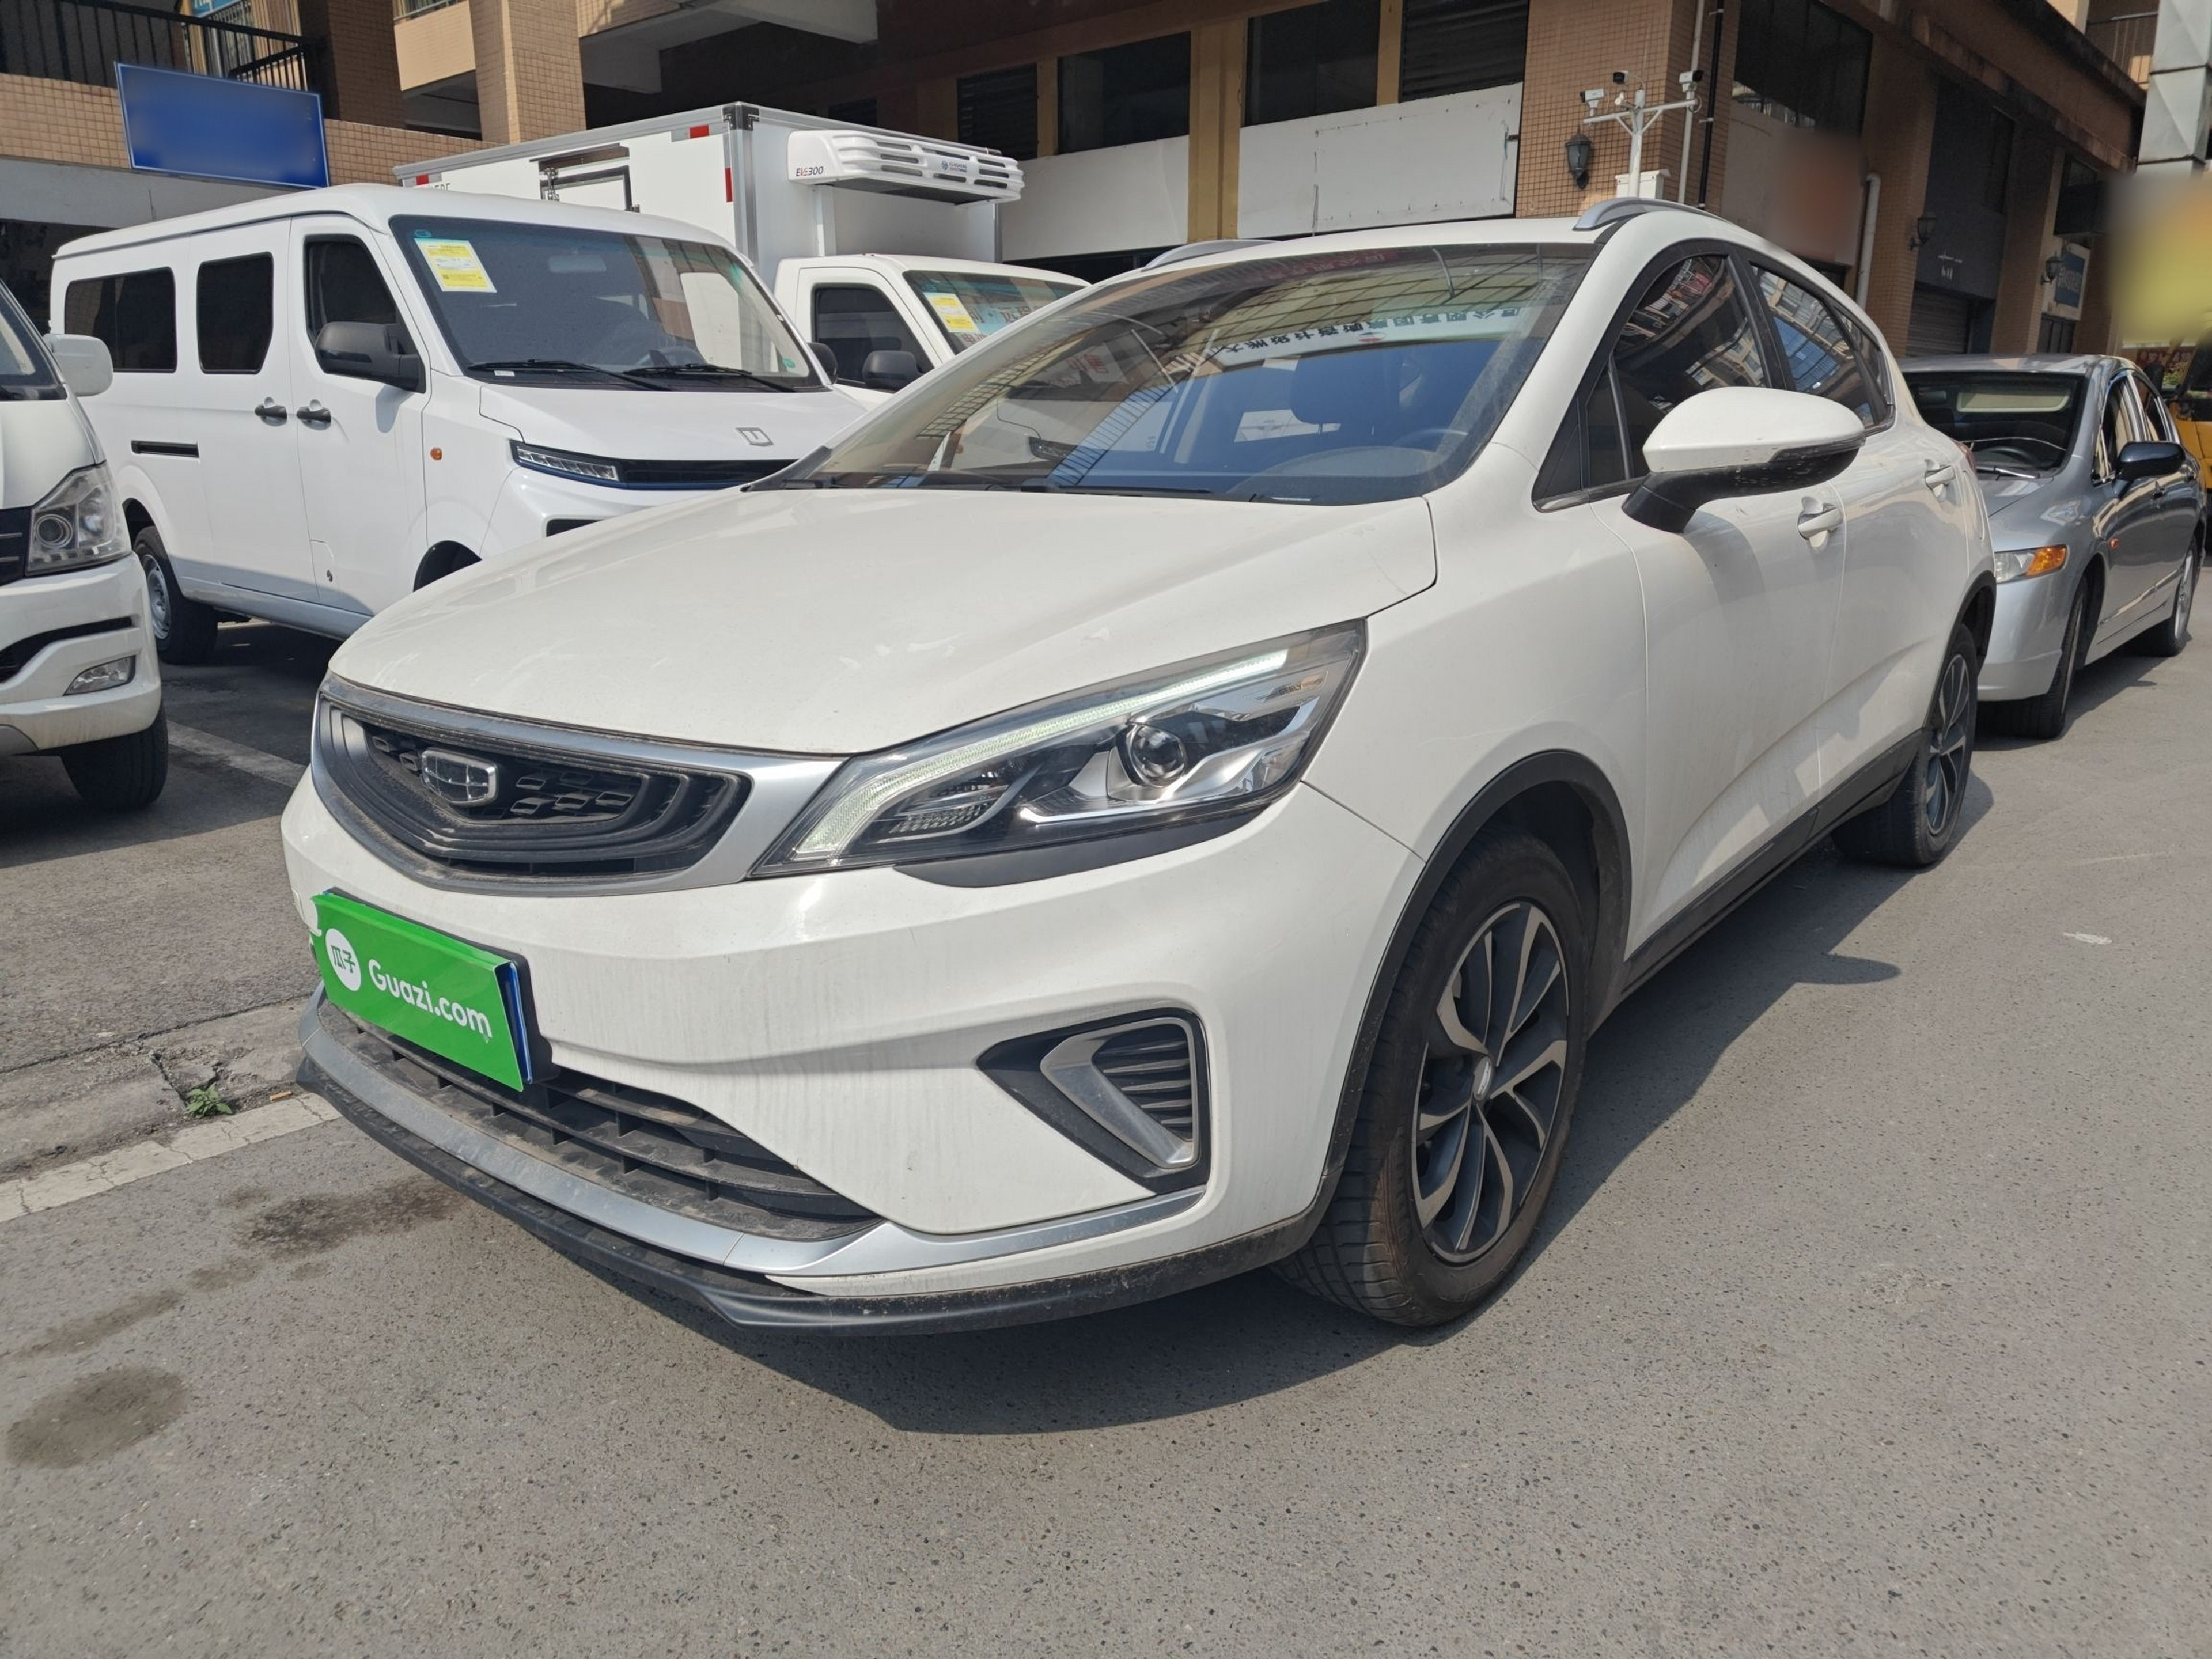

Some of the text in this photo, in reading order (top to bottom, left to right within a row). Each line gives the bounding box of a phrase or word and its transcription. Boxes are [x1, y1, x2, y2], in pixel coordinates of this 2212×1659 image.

[1278, 683, 1302, 695] GEELY
[331, 944, 356, 974] 瓜子
[368, 959, 493, 1038] Guazi.com
